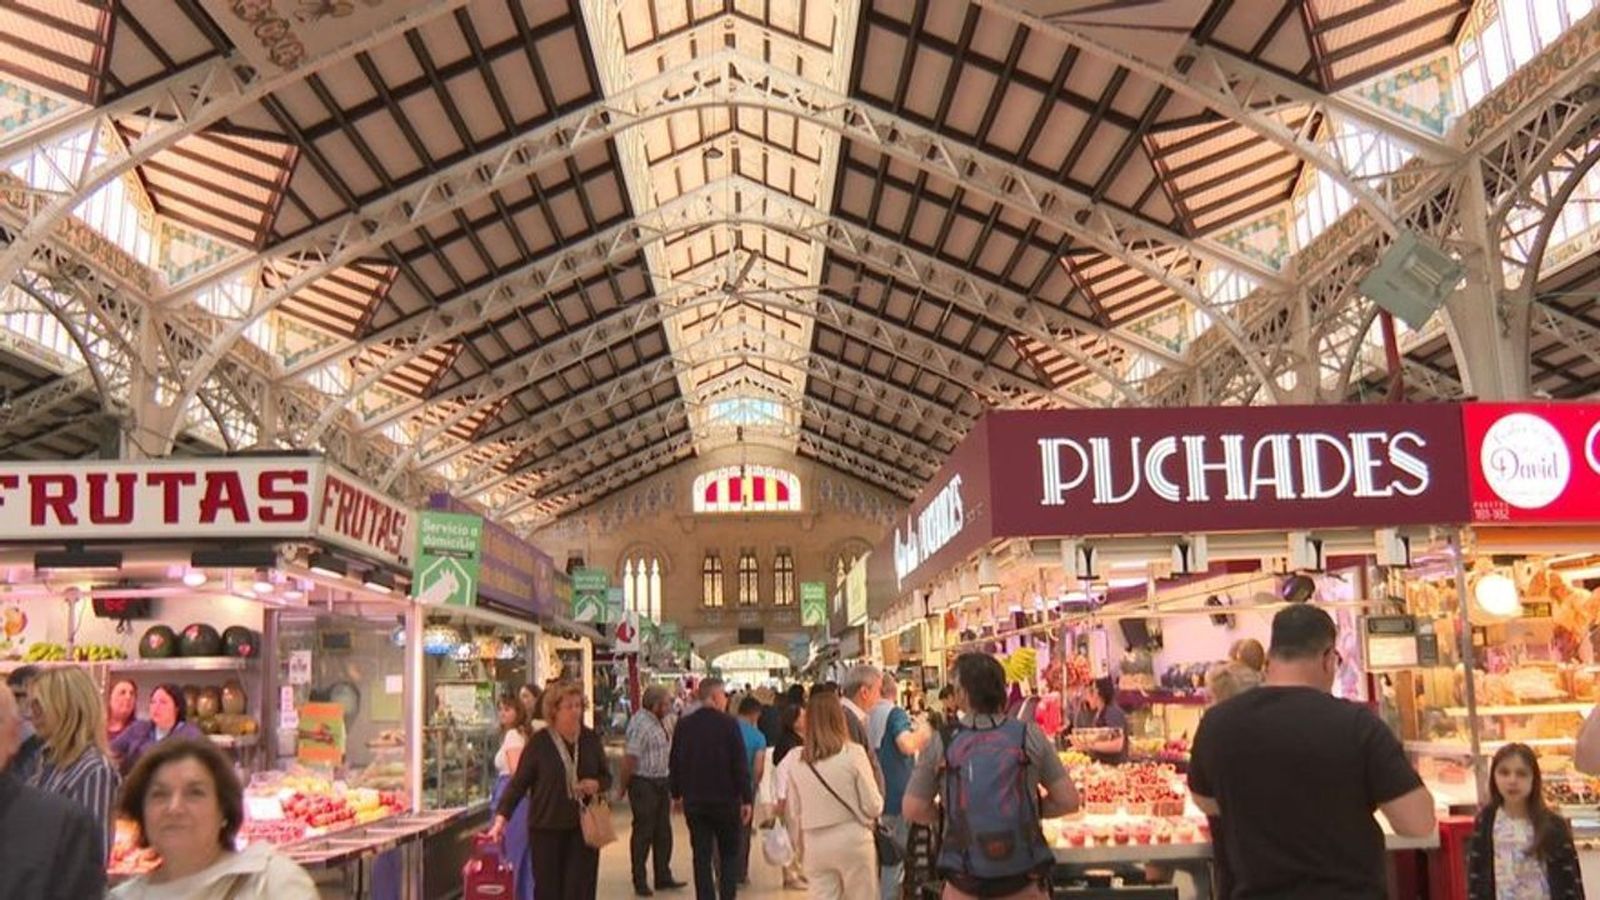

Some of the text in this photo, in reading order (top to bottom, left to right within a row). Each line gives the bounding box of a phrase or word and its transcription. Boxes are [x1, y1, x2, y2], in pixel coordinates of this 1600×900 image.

[1038, 432, 1429, 505] PUCHADES
[1490, 447, 1559, 480] David
[320, 474, 406, 555] FRUTAS
[422, 518, 469, 536] Servicio
[422, 534, 477, 550] domicilio
